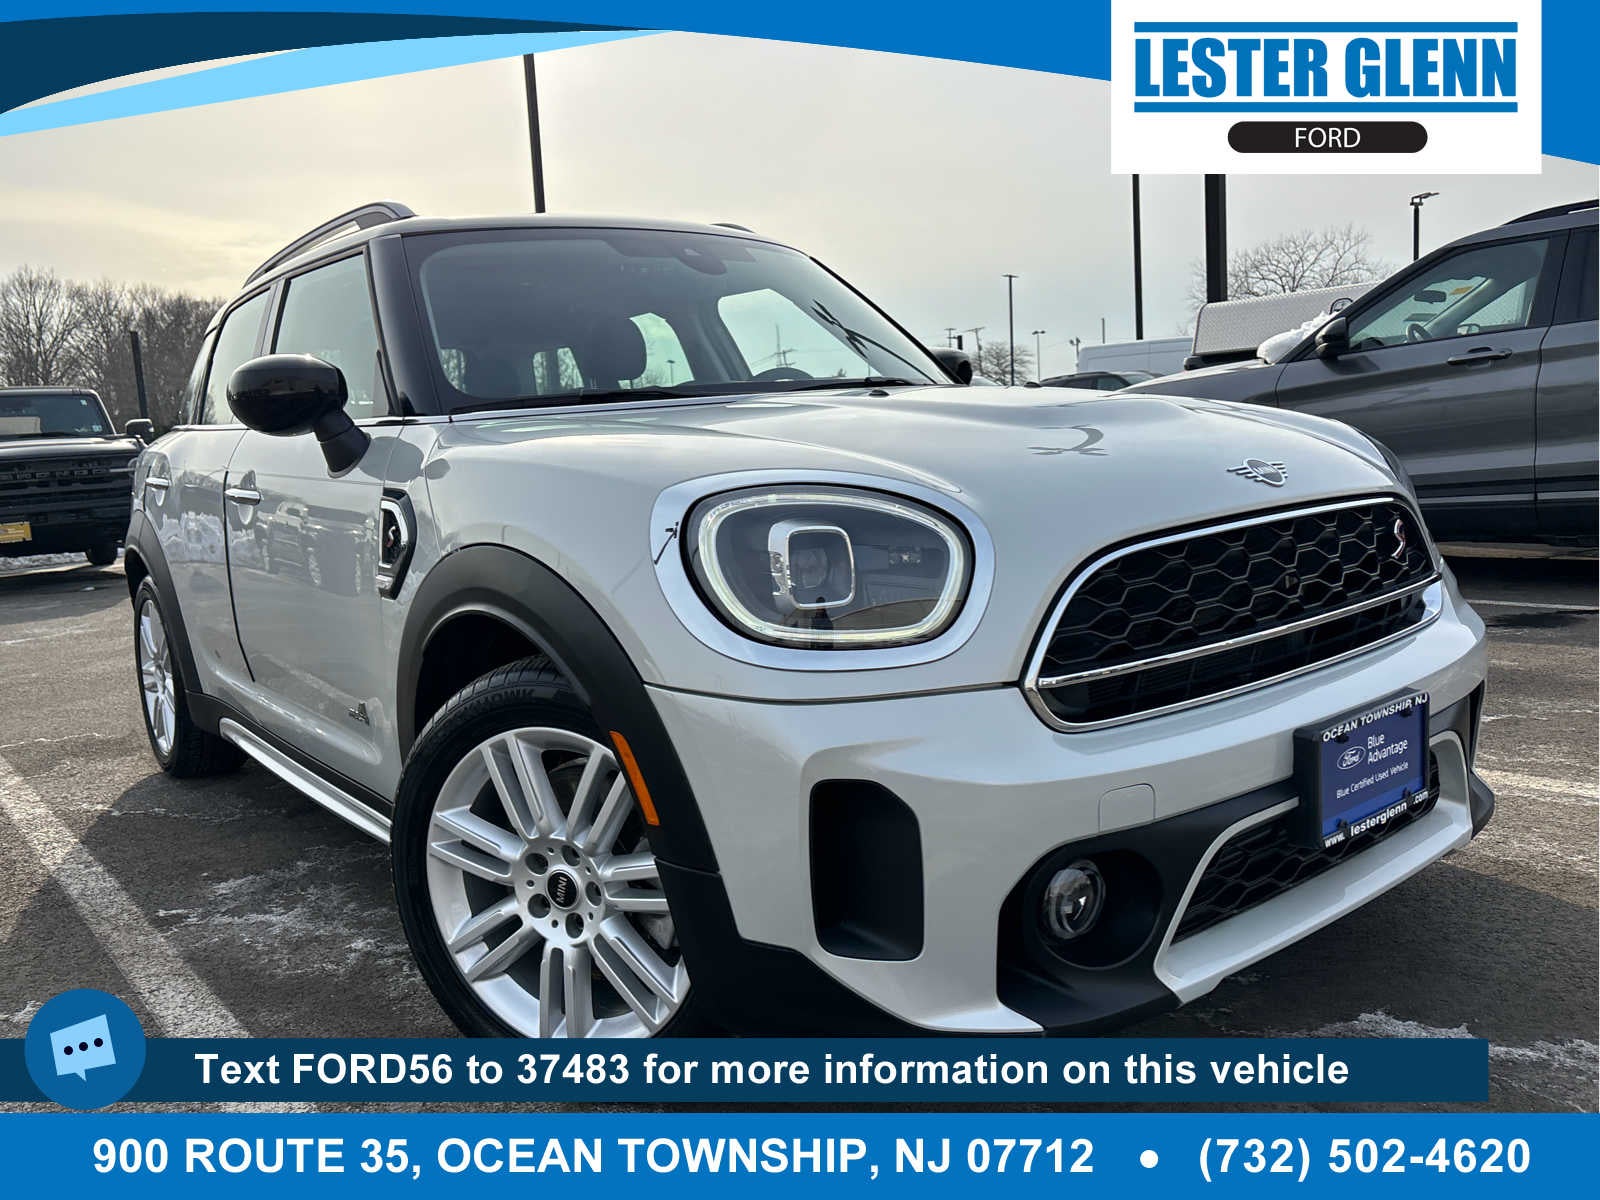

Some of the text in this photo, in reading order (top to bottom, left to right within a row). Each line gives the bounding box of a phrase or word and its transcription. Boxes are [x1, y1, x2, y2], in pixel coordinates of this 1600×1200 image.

[1322, 720, 1358, 742] OCEAN
[1414, 693, 1428, 706] NJ
[1367, 734, 1385, 749] Blue
[1367, 739, 1408, 765] Advantage
[1336, 761, 1409, 799] Blue Certified Used Vehicle
[1350, 801, 1407, 836] lesterglenn
[556, 876, 568, 904] MINI
